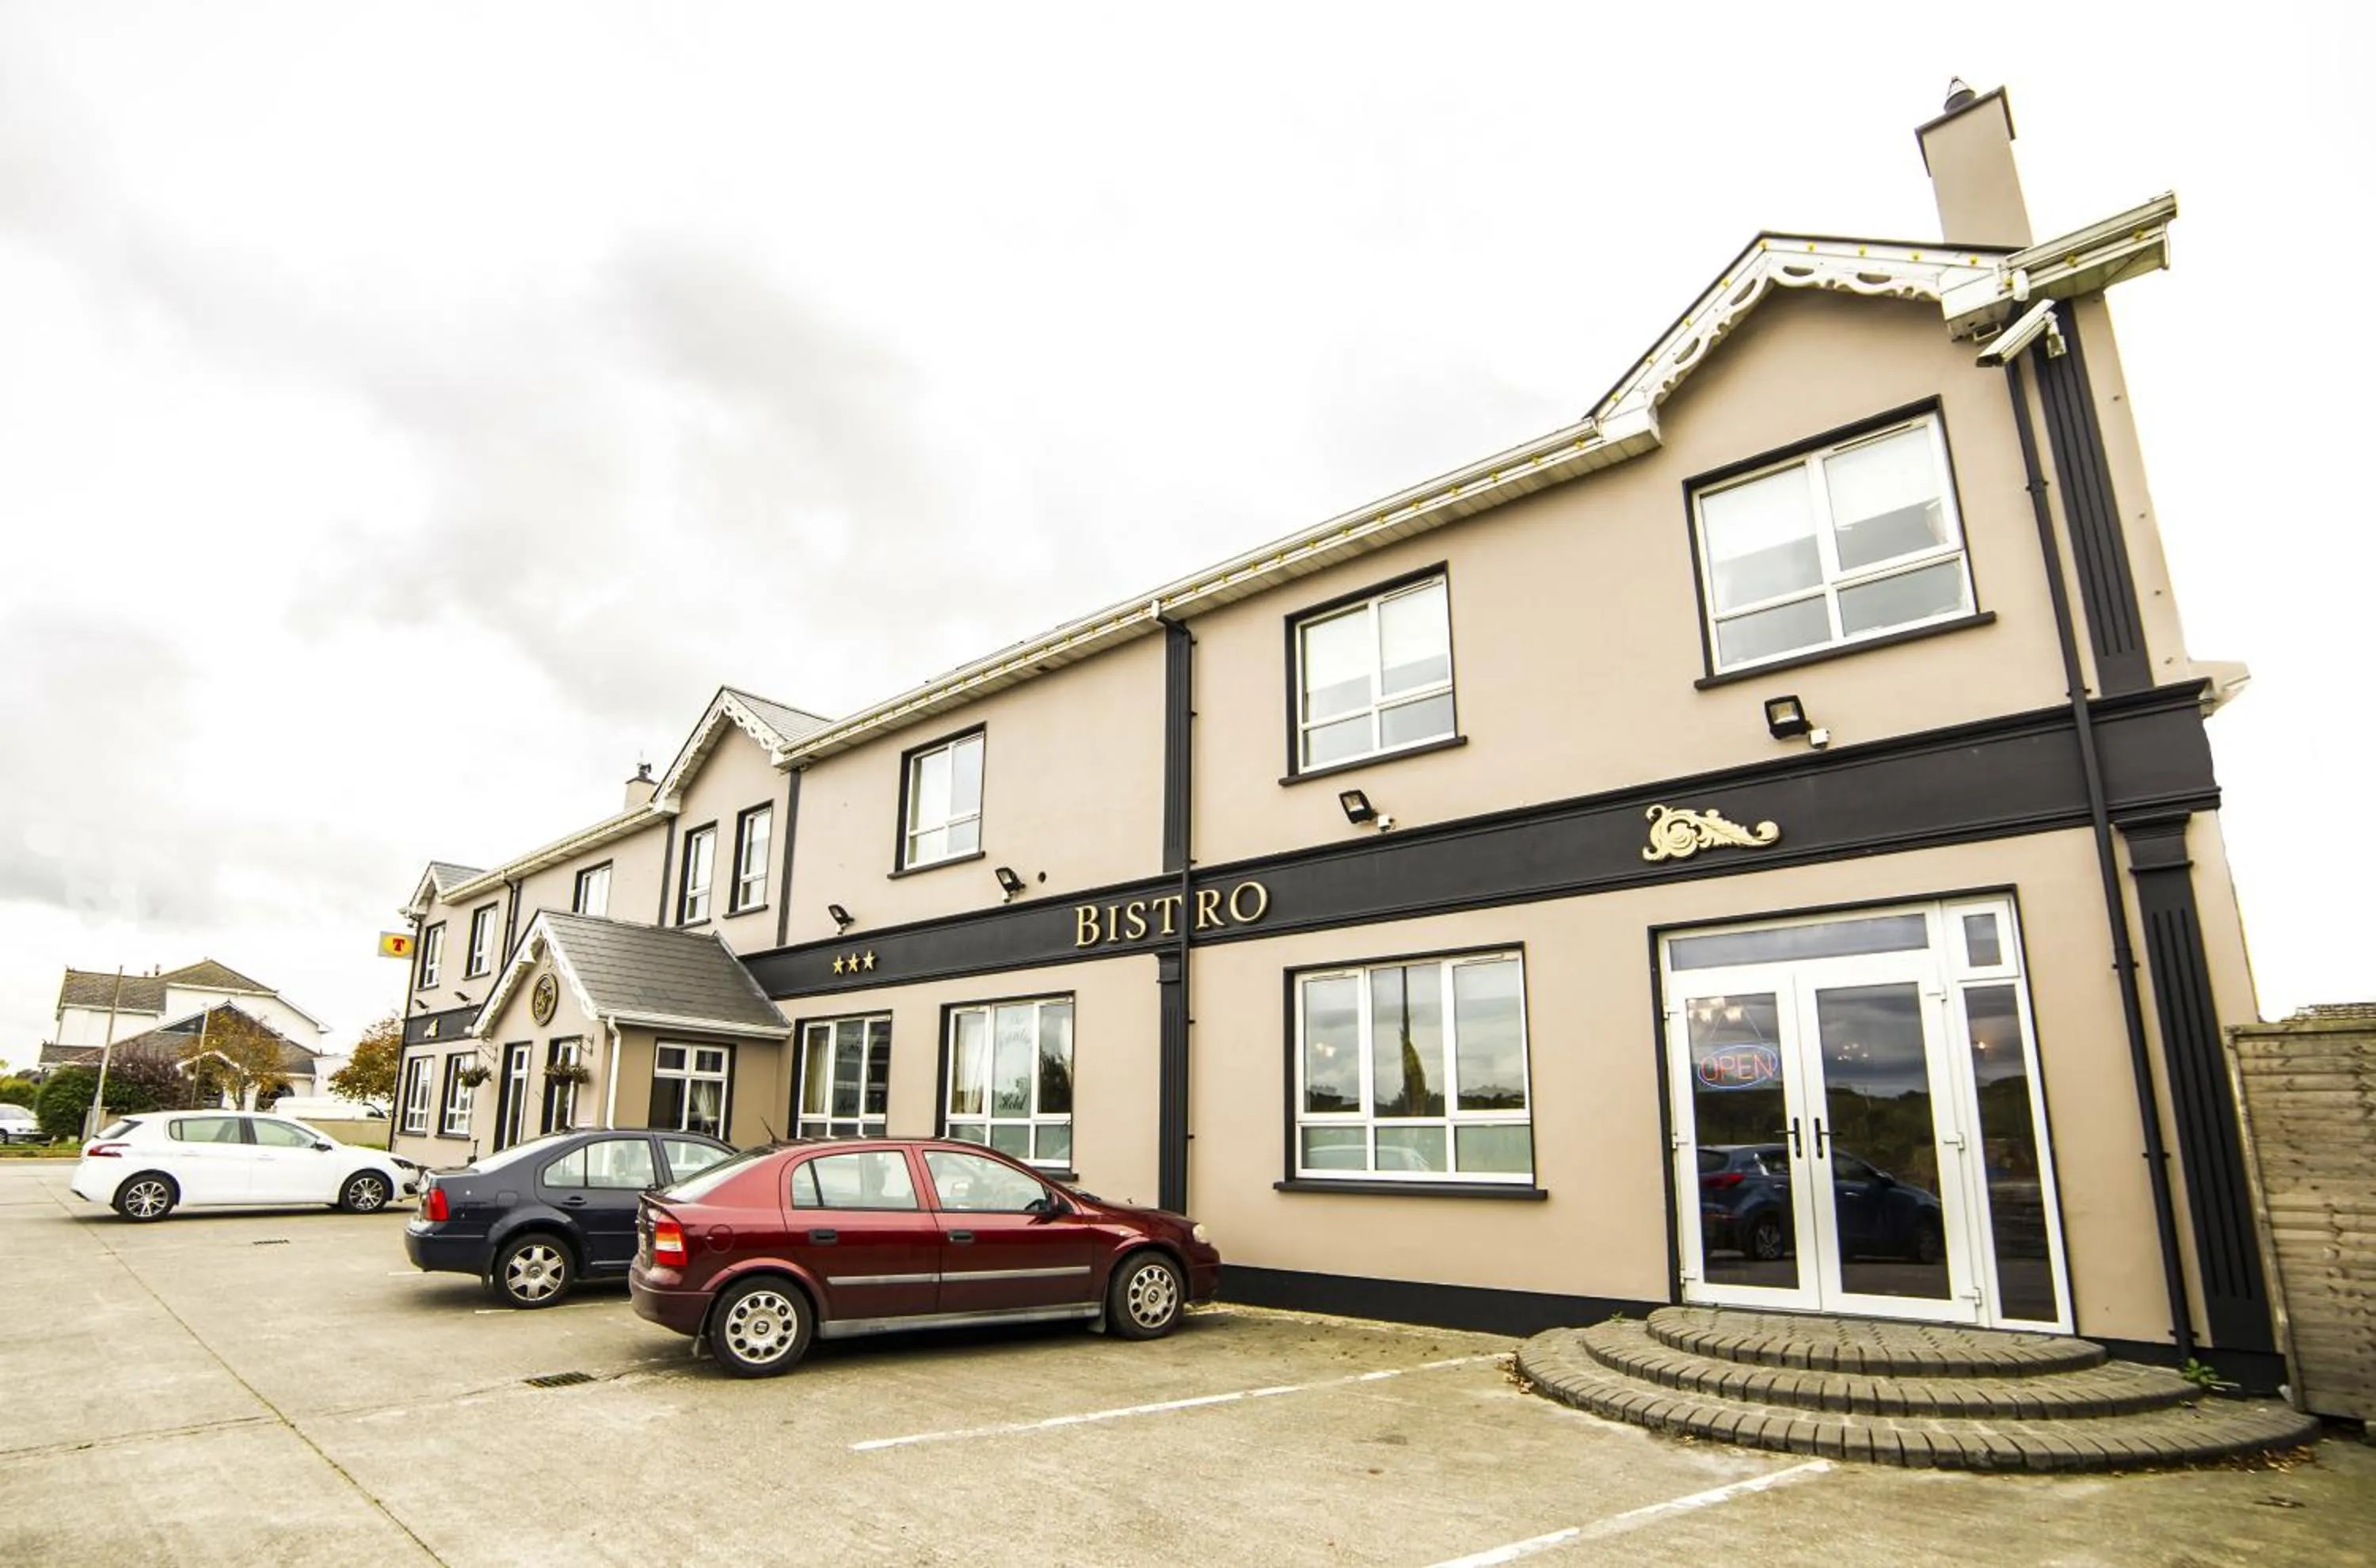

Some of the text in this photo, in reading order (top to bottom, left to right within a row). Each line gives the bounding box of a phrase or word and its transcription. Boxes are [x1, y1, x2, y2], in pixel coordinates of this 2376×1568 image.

[1075, 881, 1268, 947] BISTRO
[392, 937, 406, 951] T
[1700, 1052, 1773, 1081] OPEN
